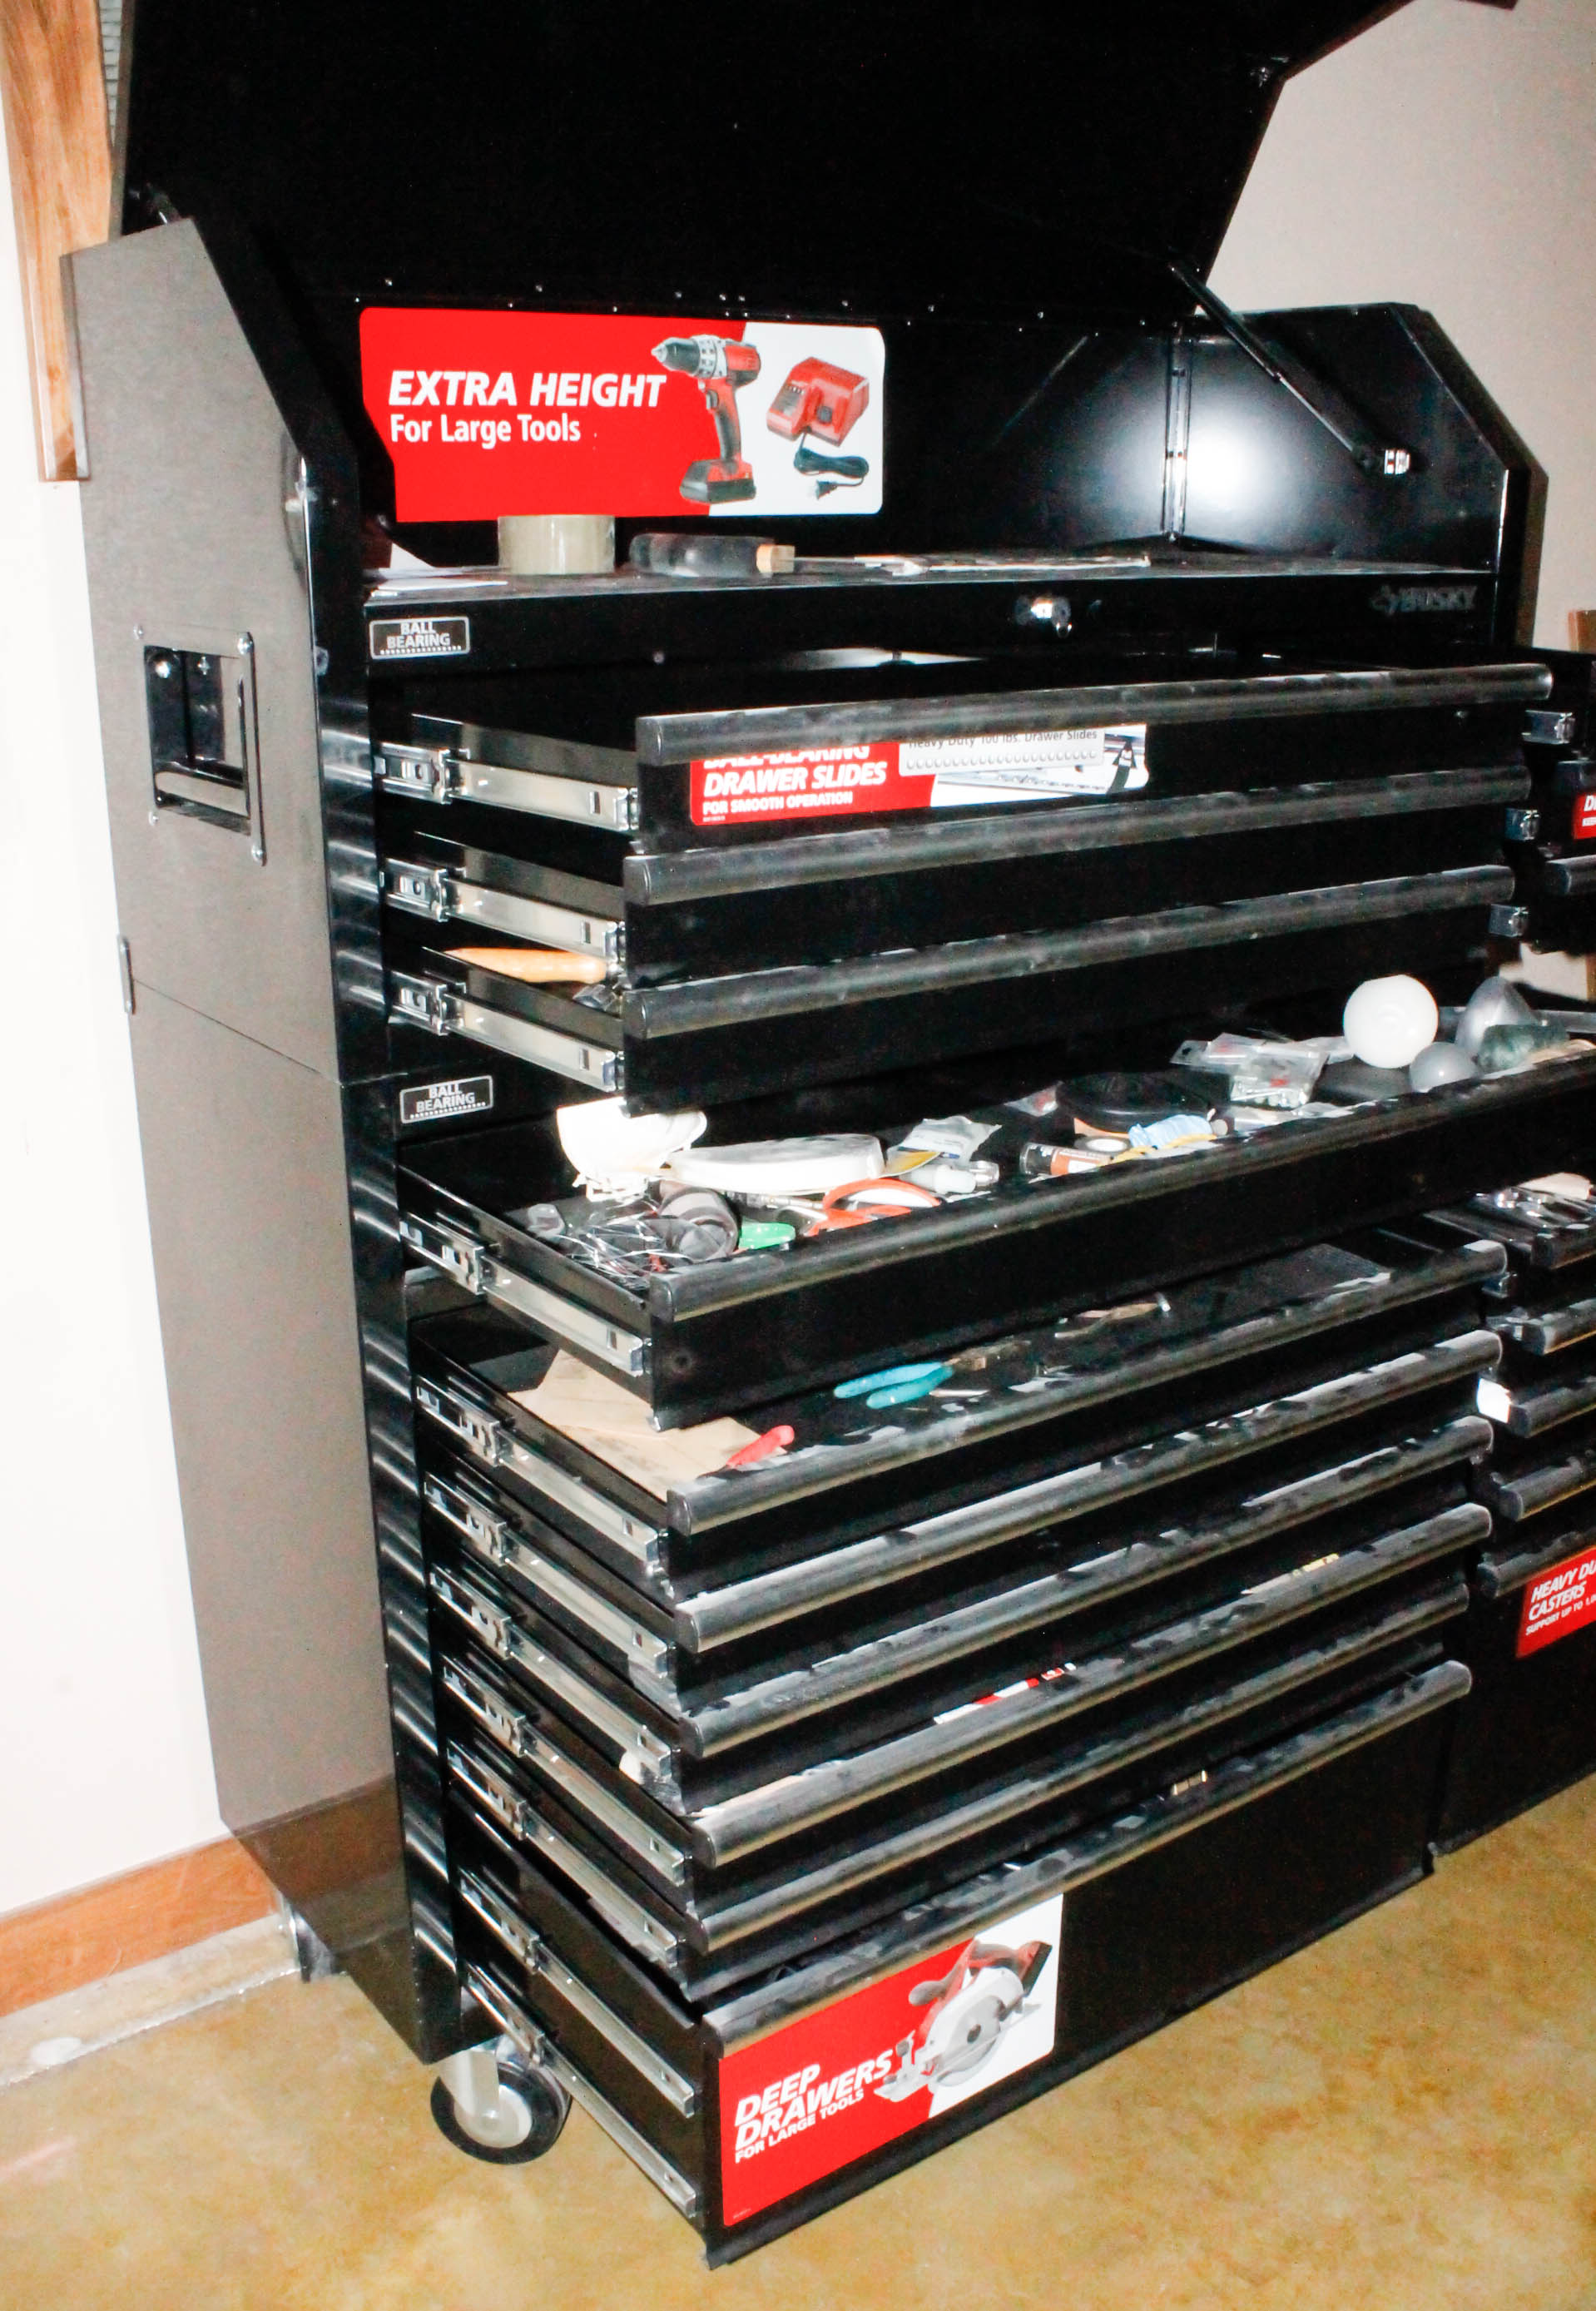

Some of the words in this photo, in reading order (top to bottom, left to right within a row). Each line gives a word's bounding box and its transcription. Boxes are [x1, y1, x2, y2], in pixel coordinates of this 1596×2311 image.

[389, 370, 518, 406] EXTRA
[529, 372, 667, 407] HEIGHT
[390, 414, 432, 442] For
[440, 414, 511, 449] Large
[517, 412, 581, 442] Tools
[387, 633, 450, 648] BEARING
[400, 622, 436, 635] BALL
[1067, 730, 1098, 740] Slides
[704, 766, 808, 797] DRAWER
[811, 761, 888, 789] SLIDES
[702, 800, 728, 815] FOR
[731, 796, 784, 813] SMOOTH
[786, 791, 853, 808] OPERATION
[416, 1093, 475, 1113] BEARING
[429, 1084, 463, 1098] BALL
[1529, 1580, 1587, 1620] CASTERS
[1531, 1568, 1579, 1603] HEAVY
[1525, 1611, 1560, 1635] SUPPORT
[1561, 1606, 1573, 1618] UP
[1573, 1600, 1583, 1612] TO
[735, 2064, 821, 2126] DEEP
[735, 2049, 894, 2151] DRAWERS
[735, 2140, 765, 2164] FOR
[768, 2114, 816, 2146] LARGE
[820, 2088, 864, 2119] TOOLS
